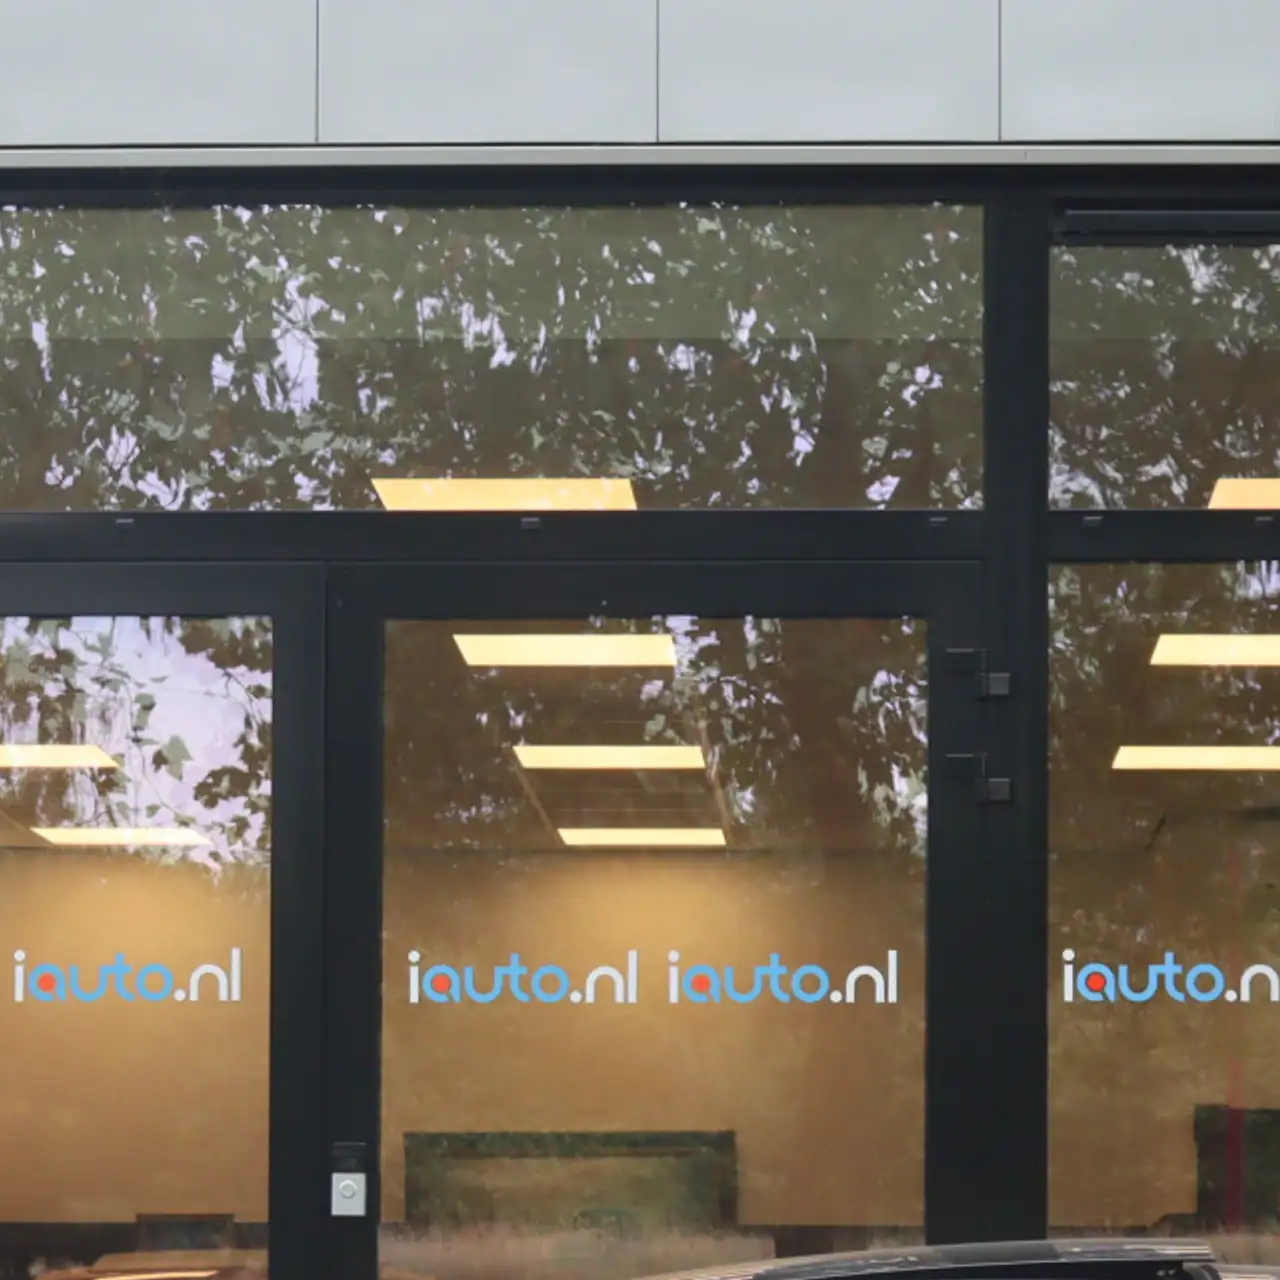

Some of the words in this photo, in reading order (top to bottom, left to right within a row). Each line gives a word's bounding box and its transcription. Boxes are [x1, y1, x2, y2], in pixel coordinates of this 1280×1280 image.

[13, 947, 241, 1002] iauto.nl
[408, 949, 637, 1003] iauto.nl
[668, 949, 897, 1003] iauto.nl
